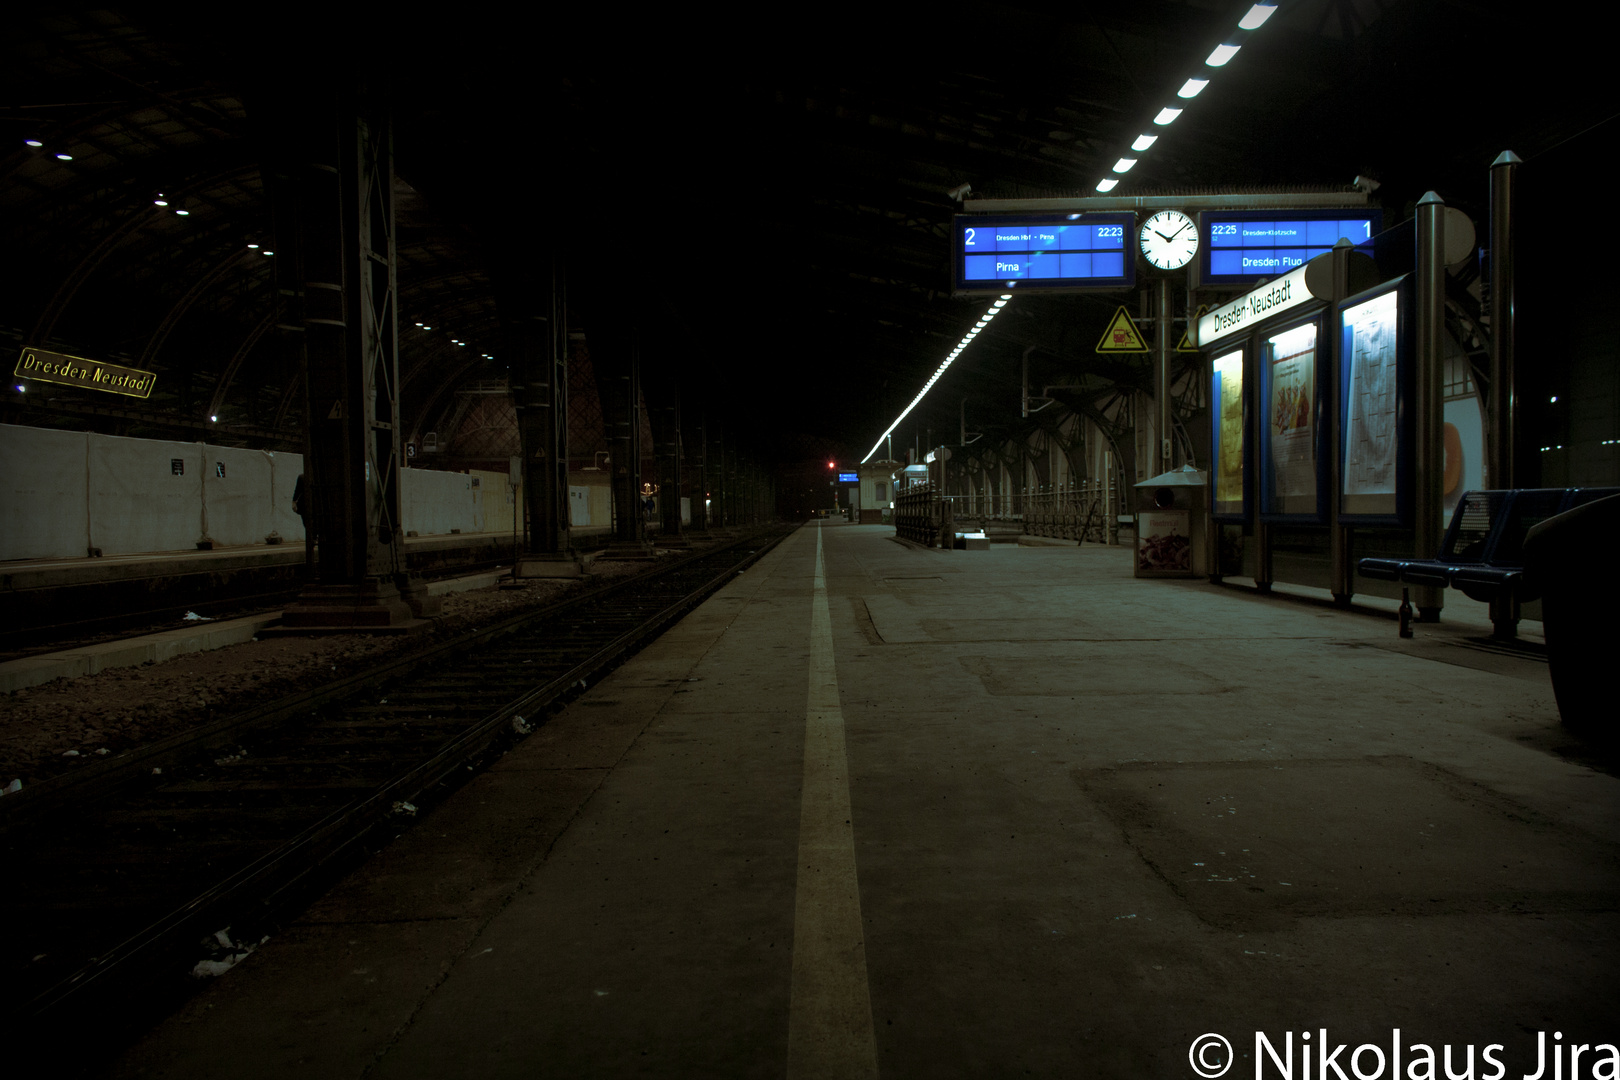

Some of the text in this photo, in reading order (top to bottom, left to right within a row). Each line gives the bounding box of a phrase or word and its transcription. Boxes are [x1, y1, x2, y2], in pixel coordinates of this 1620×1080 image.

[1098, 226, 1123, 238] 22:23
[1211, 224, 1237, 235] 22:25
[1242, 229, 1297, 237] Dresden-Klotzsche
[1362, 221, 1371, 238] 1
[965, 227, 976, 245] 2
[996, 234, 1020, 242] Dresden
[996, 262, 1020, 272] Pirna
[1242, 257, 1280, 267] Dresden
[1214, 279, 1291, 333] Dresden-Neustadt
[23, 353, 151, 391] Dresden-Neustadt
[407, 445, 416, 457] 3
